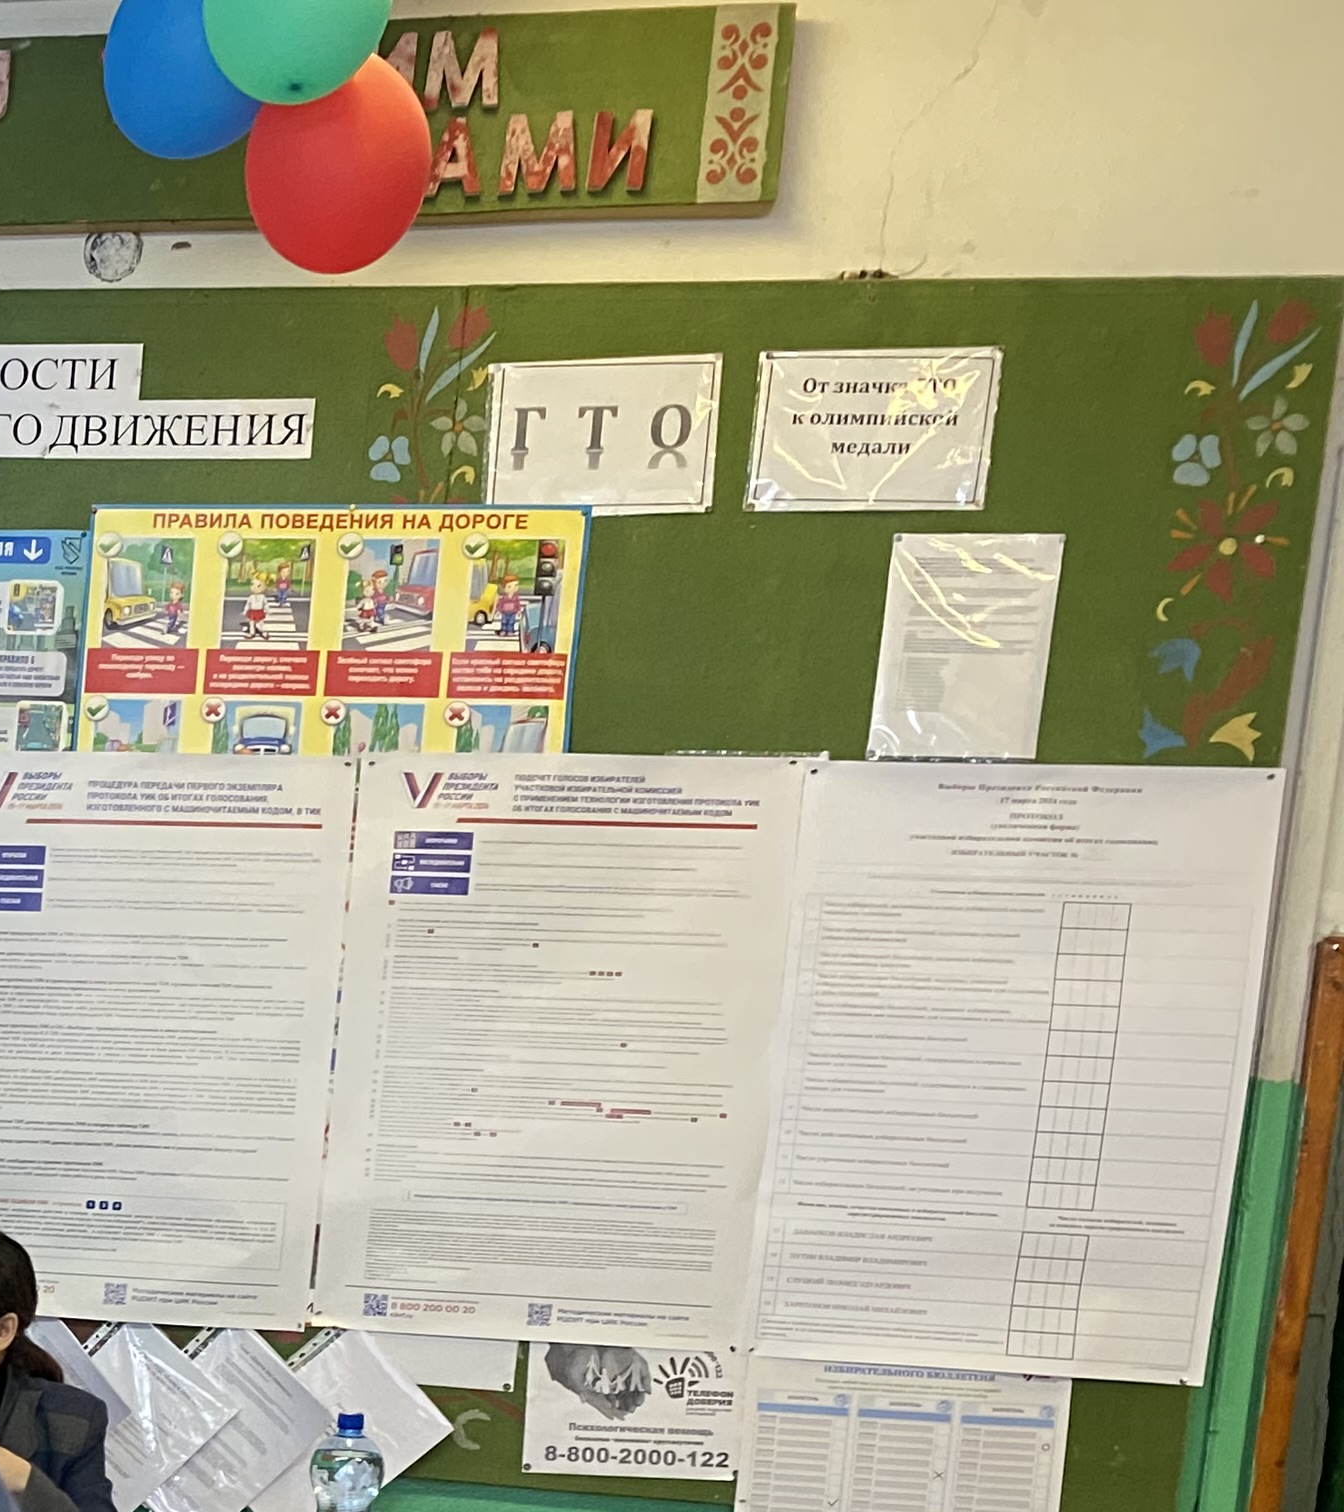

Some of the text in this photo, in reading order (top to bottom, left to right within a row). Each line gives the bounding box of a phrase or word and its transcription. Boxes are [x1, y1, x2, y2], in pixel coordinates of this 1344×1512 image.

[423, 108, 654, 199] АМИ
[802, 376, 830, 394] От
[791, 412, 806, 426] к
[48, 412, 309, 453] ДВИЖЕНИЯ
[830, 441, 912, 458] медали
[153, 512, 530, 534] ПРАВИЛА ПОВЕДЕНИЯ НА ДОРОГЕ
[22, 771, 63, 781] ВЫБОРЫ
[399, 1302, 420, 1312] 800
[423, 1303, 443, 1313] 200
[445, 1304, 460, 1314] 00
[462, 1305, 476, 1315] 20
[686, 1389, 734, 1398] ТЕЛЕФОН
[686, 1397, 734, 1407] ДОВЕРИЯ
[568, 1422, 665, 1435] Психологическая
[544, 1445, 730, 1468] 8-800-2000-122
